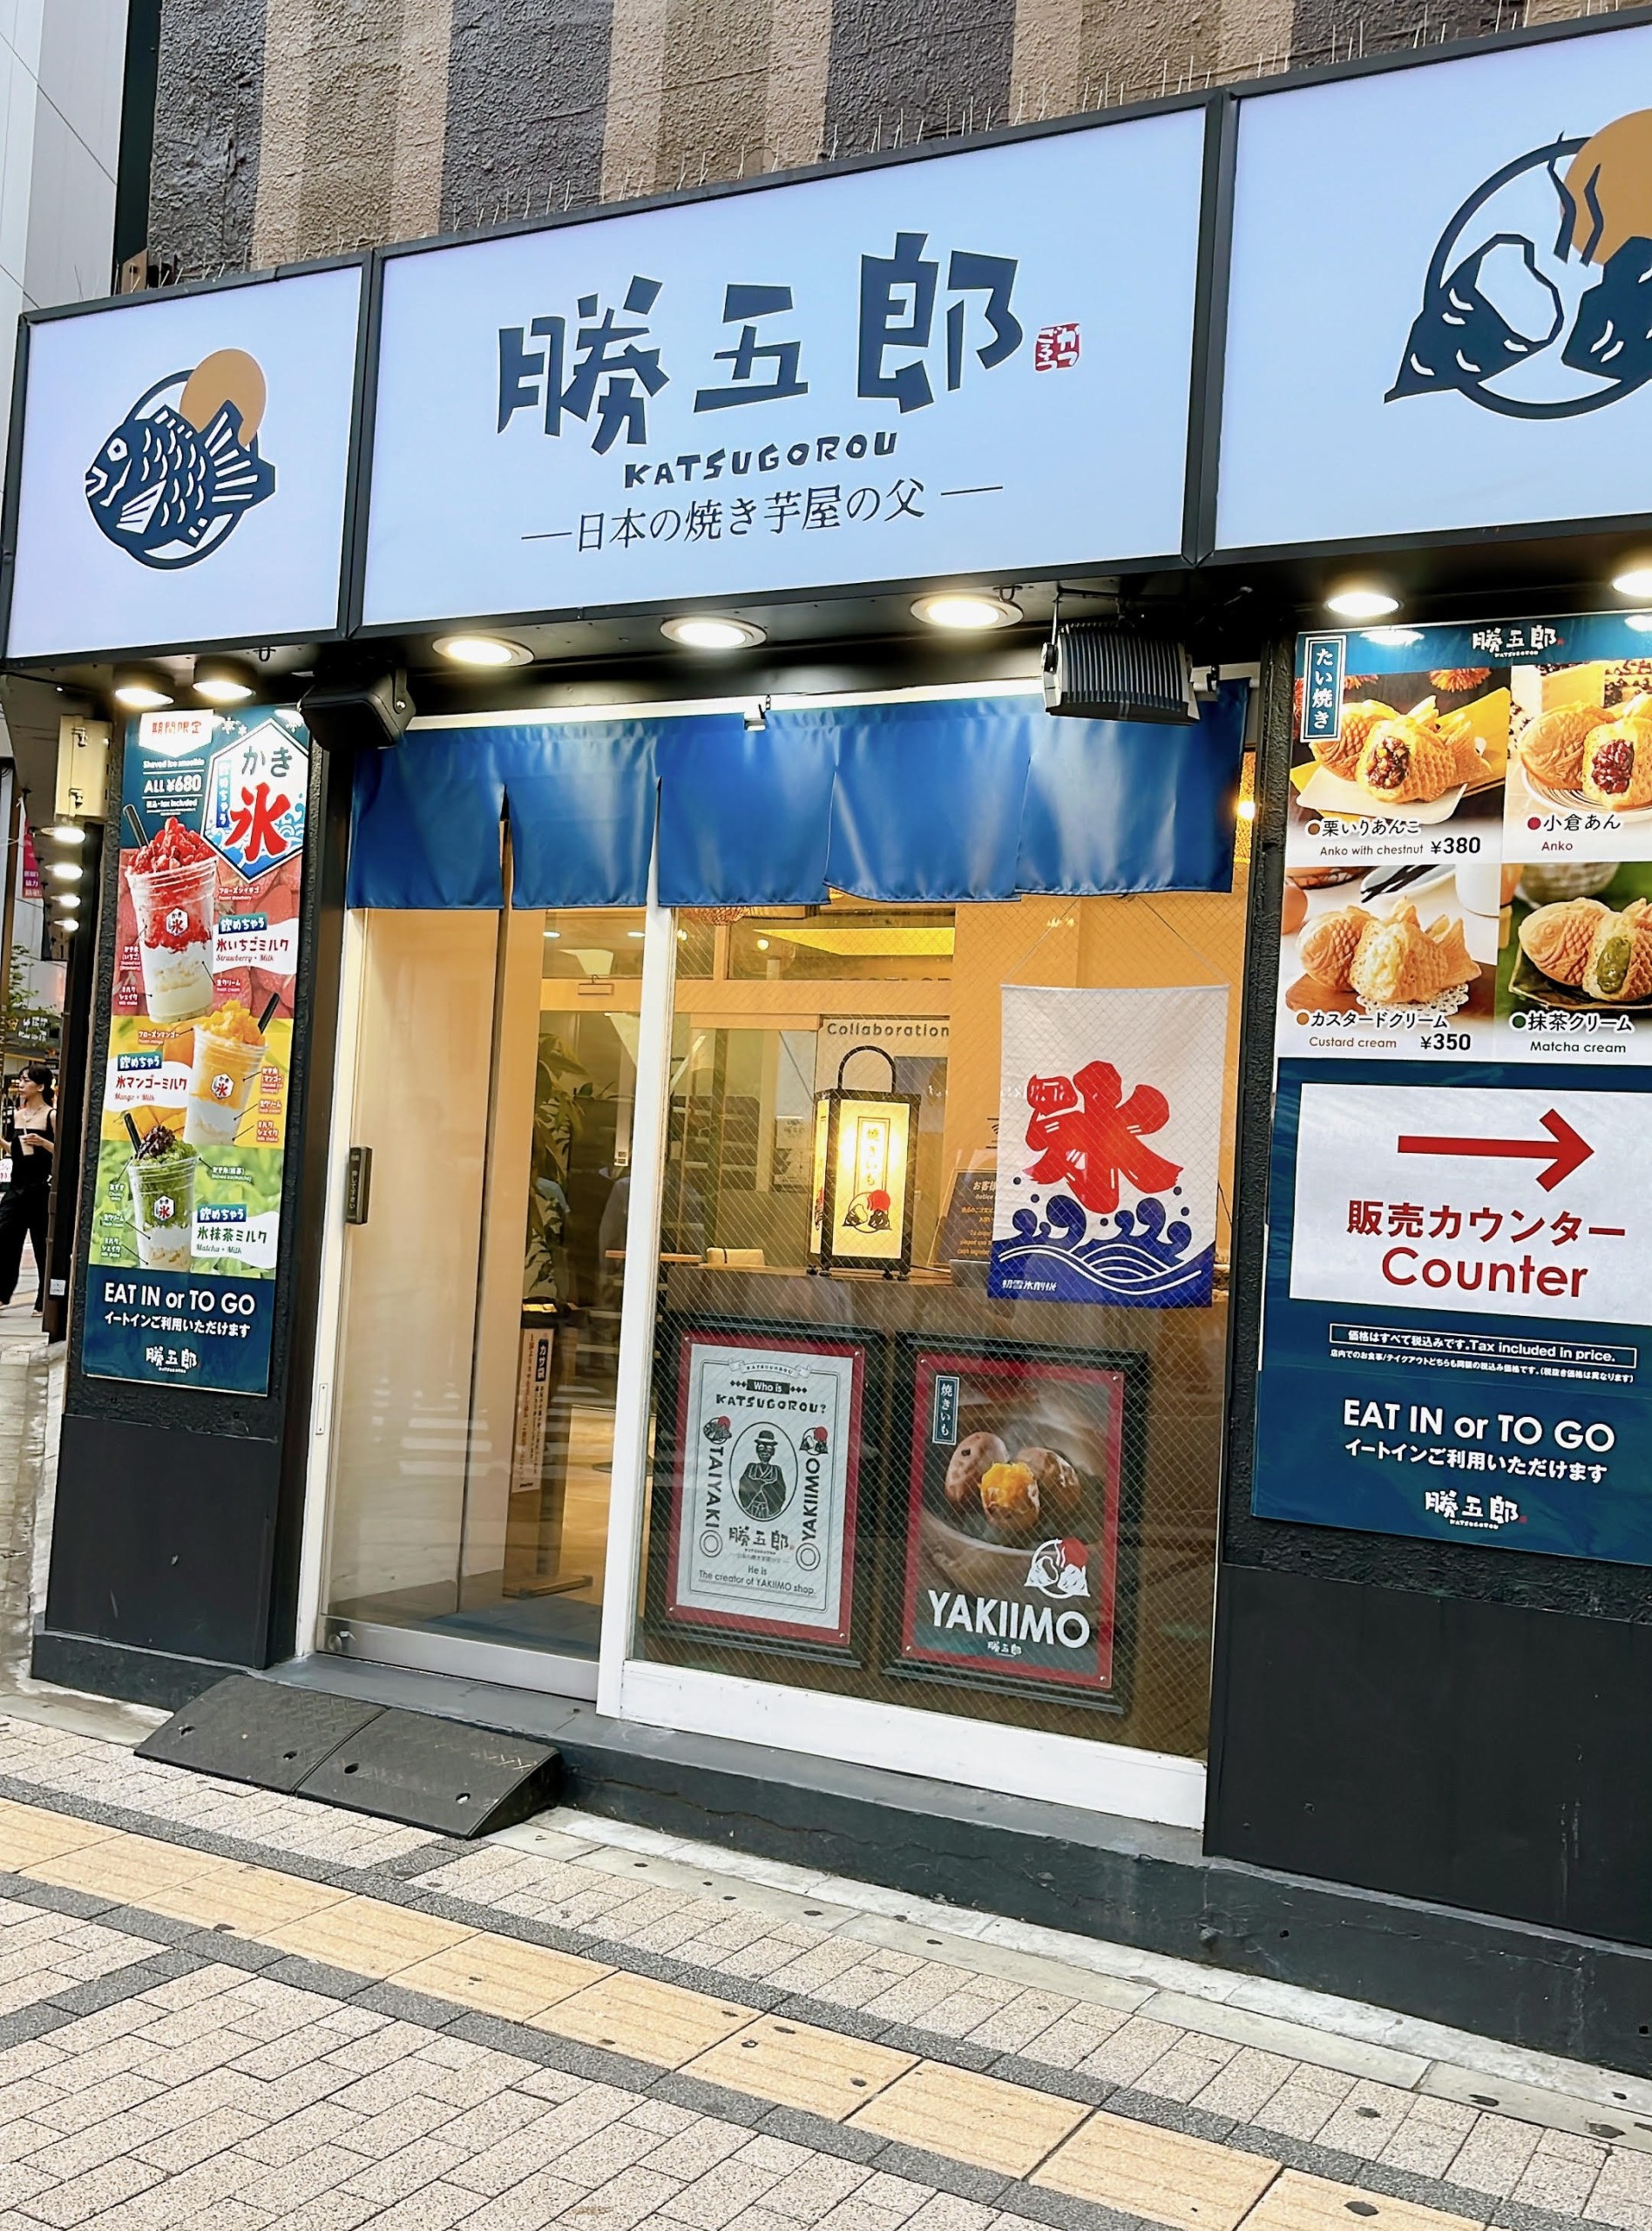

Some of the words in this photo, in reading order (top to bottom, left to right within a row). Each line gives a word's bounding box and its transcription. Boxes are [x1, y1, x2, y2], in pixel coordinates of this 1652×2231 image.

[497, 232, 1025, 456] 勝五郎
[625, 431, 897, 488] KATSUGOROU
[1473, 625, 1557, 653] 勝五郎
[1311, 648, 1335, 729] たい焼き
[241, 746, 293, 777] かき
[144, 779, 165, 793] ALL
[166, 774, 202, 792] ¥680
[224, 782, 291, 862] 氷
[1322, 818, 1422, 838] 栗いりあんこ
[1543, 814, 1622, 832] 小倉あん
[1320, 846, 1348, 857] Anko
[1351, 845, 1373, 856] with
[1376, 844, 1424, 855] chestnut
[1431, 837, 1481, 856] ¥380
[1541, 841, 1574, 852] Anko
[220, 917, 265, 932] 飲めちゃう
[216, 937, 289, 952] 氷いちごミルク
[828, 1022, 950, 1037] Collaboration
[1312, 1014, 1448, 1028] カスタードクリーム
[1529, 1014, 1633, 1031] 抹茶クリーム
[1310, 1037, 1354, 1048] Custard
[1420, 1034, 1471, 1050] ¥350
[1530, 1041, 1579, 1053] Matcha
[1584, 1043, 1627, 1053] cream
[119, 1055, 160, 1069] 飲めちゃう
[116, 1075, 187, 1090] 氷マンゴーミルク
[1022, 1061, 1183, 1214] 氷
[200, 1207, 244, 1221] 飲めちゃう
[1347, 1200, 1626, 1246] 販売カウンター
[197, 1226, 267, 1244] 氷抹茶ミルク
[1382, 1247, 1588, 1298] Counter
[105, 1282, 137, 1305] EAT
[141, 1285, 160, 1306] IN
[166, 1292, 185, 1309] or
[189, 1290, 215, 1312] TO
[220, 1292, 255, 1315] GO
[105, 1311, 251, 1338] イートインご利用いただけます
[146, 1346, 198, 1369] 勝五郎
[1499, 1341, 1556, 1358] included
[1560, 1347, 1572, 1359] in
[1575, 1351, 1616, 1362] price.
[754, 1380, 774, 1392] Who
[775, 1383, 782, 1393] is
[715, 1394, 827, 1414] KATSUGOROU?
[941, 1383, 953, 1436] 焼きいも
[1344, 1399, 1401, 1430] EAT
[1410, 1405, 1443, 1435] IN
[1454, 1417, 1489, 1440] or
[1498, 1414, 1543, 1445] TO
[1554, 1421, 1615, 1453] GO
[1344, 1438, 1608, 1483] イートインご利用いただけます
[706, 1447, 724, 1528] TAIYAKI
[802, 1458, 820, 1541] YAKIIMO
[1425, 1490, 1520, 1524] 勝五郎
[728, 1526, 789, 1550] 勝五郎
[699, 1570, 713, 1579] The
[714, 1575, 744, 1583] creator
[756, 1580, 792, 1591] YAKIIMO
[748, 1565, 759, 1575] He
[928, 1590, 1090, 1649] YAKIIMO
